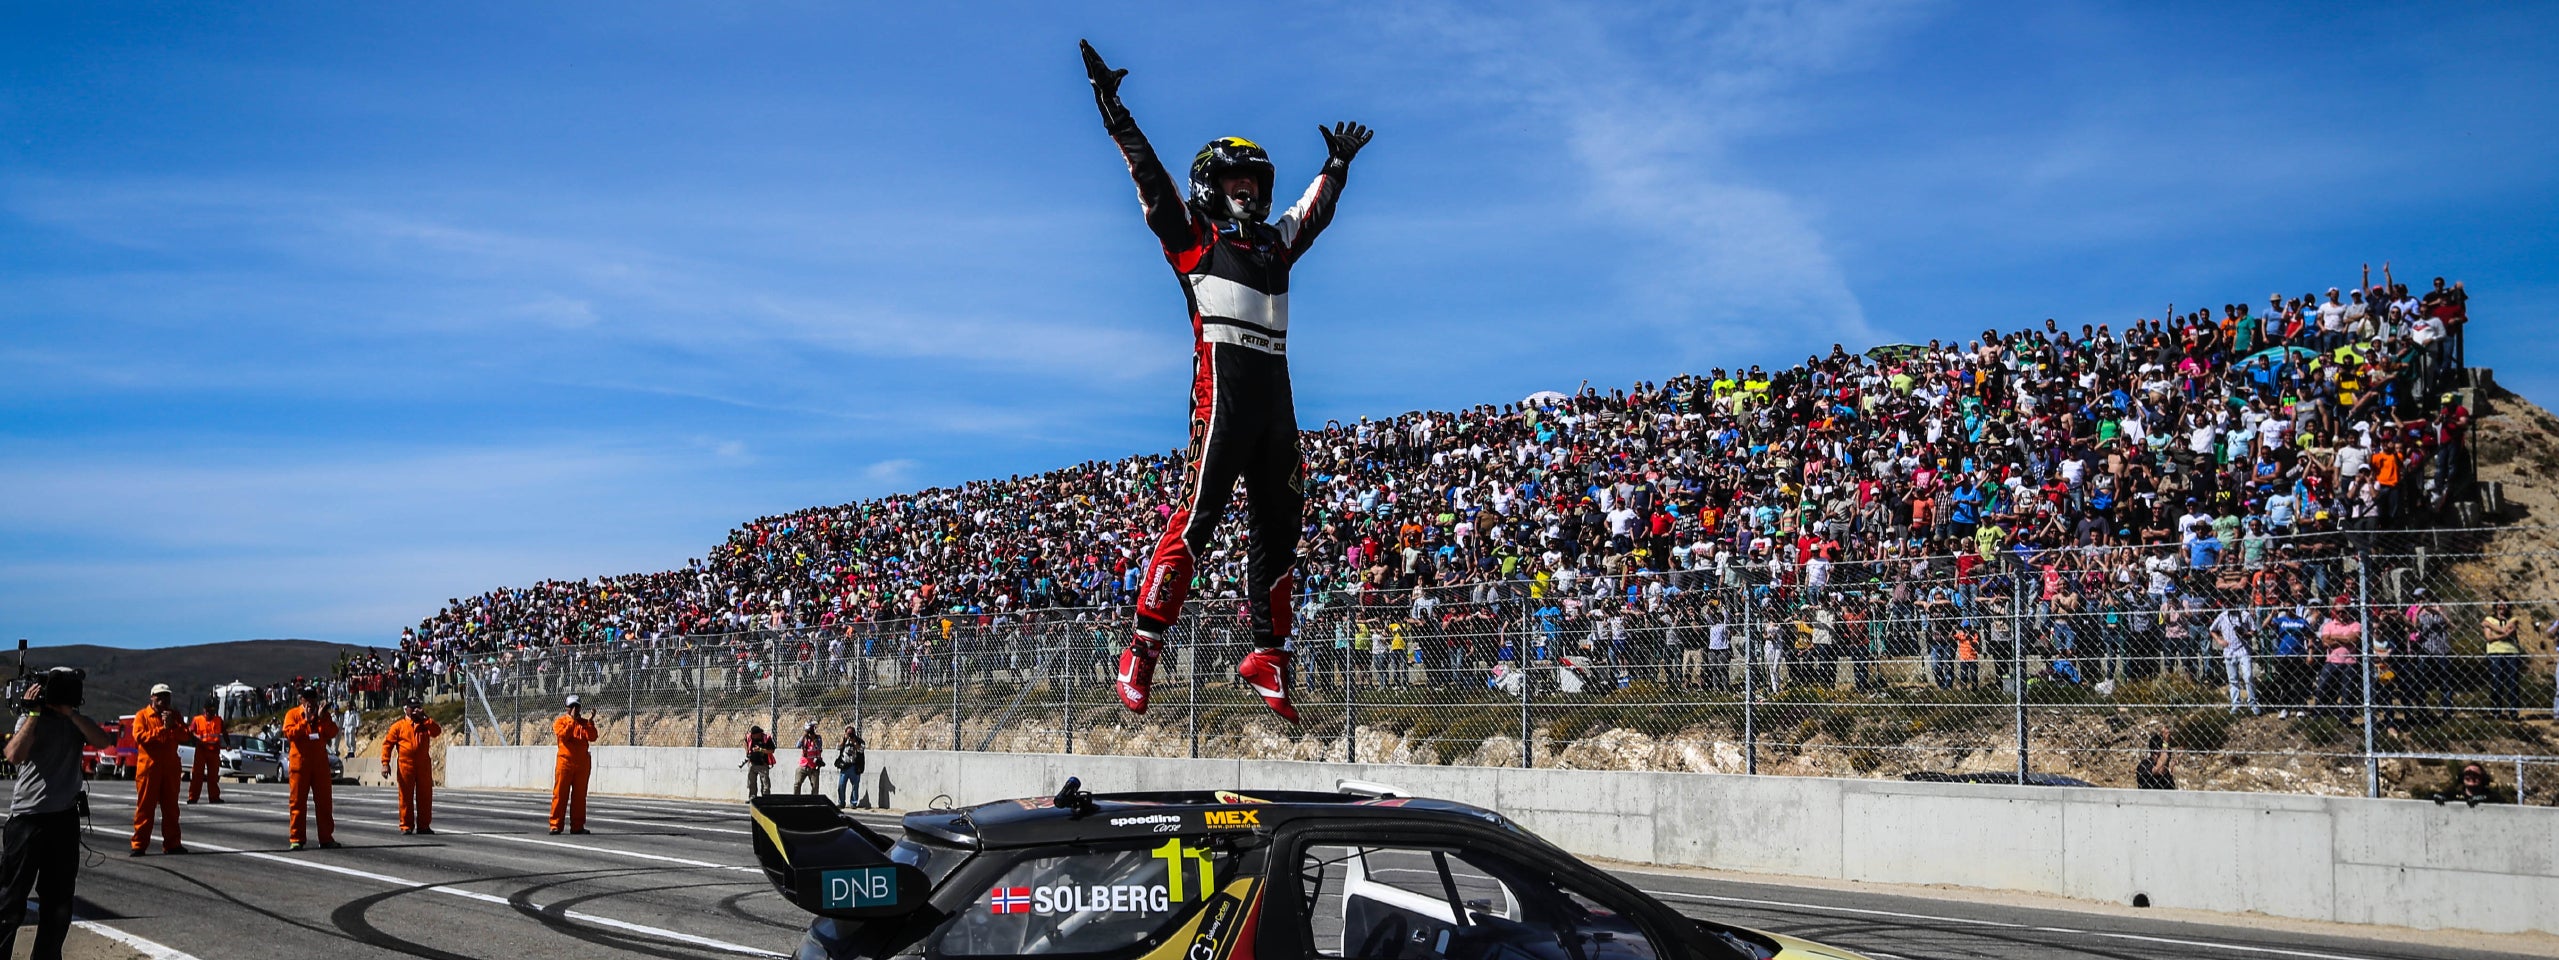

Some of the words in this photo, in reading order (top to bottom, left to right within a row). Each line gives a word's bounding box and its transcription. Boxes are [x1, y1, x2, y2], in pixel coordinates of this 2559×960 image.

[1241, 333, 1270, 348] PETTER
[1110, 814, 1181, 827] speedline
[1204, 810, 1260, 824] MEX
[1153, 823, 1182, 833] Corse
[1151, 837, 1214, 903] 11
[832, 868, 889, 908] DNB
[1034, 885, 1168, 913] SOLBERG
[1205, 919, 1221, 941] Galway
[1214, 900, 1230, 921] Carbon
